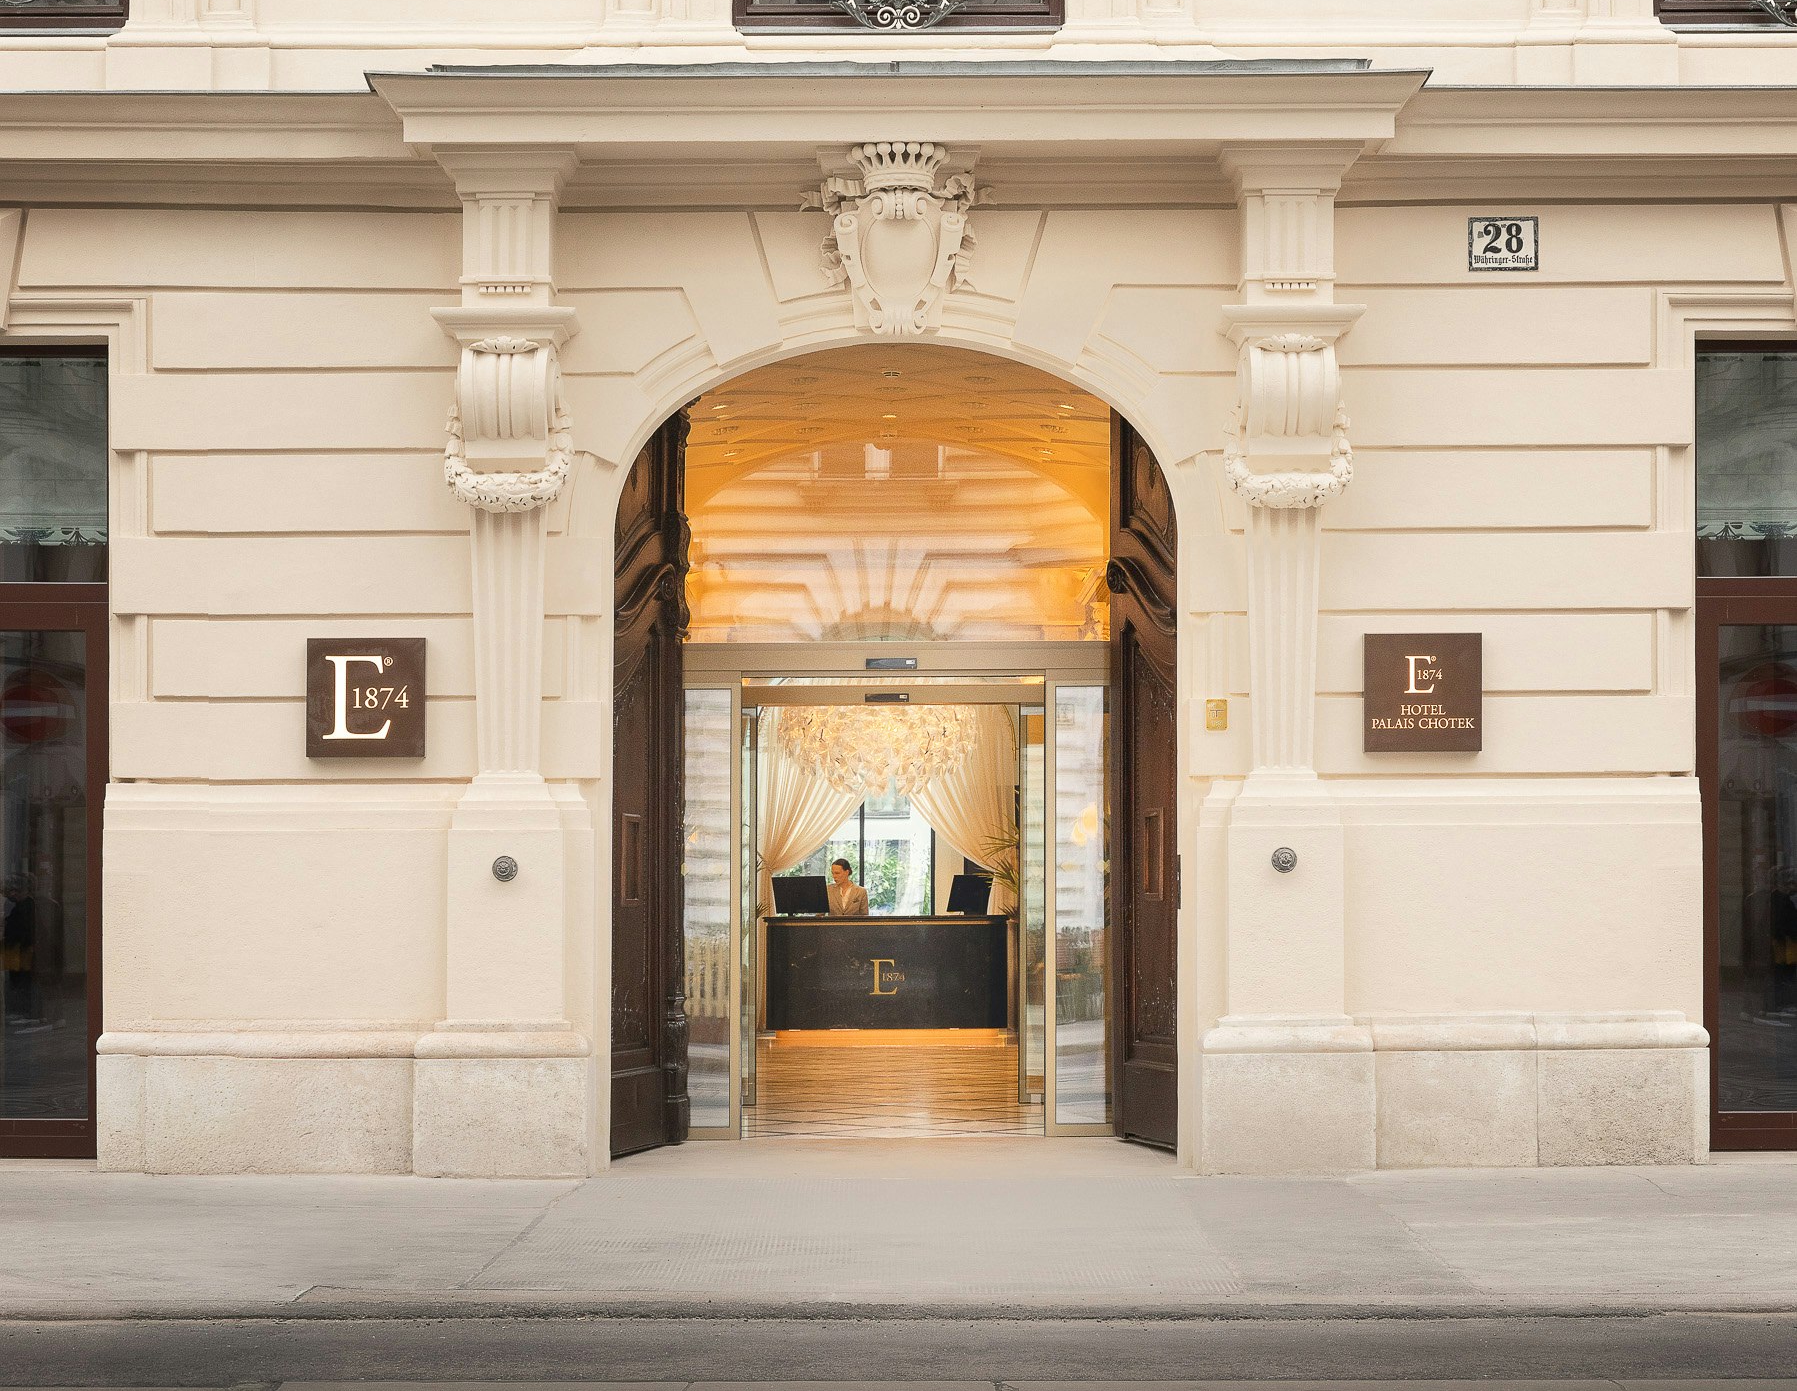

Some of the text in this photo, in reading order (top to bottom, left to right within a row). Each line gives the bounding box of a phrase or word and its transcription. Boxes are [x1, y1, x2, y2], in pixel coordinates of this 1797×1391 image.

[1482, 222, 1524, 254] 28
[1417, 668, 1443, 680] 1874
[352, 684, 409, 710] 1874
[1400, 704, 1446, 716] HOTEL
[1371, 718, 1475, 729] PALAIS CHOTEK
[869, 959, 898, 995] E
